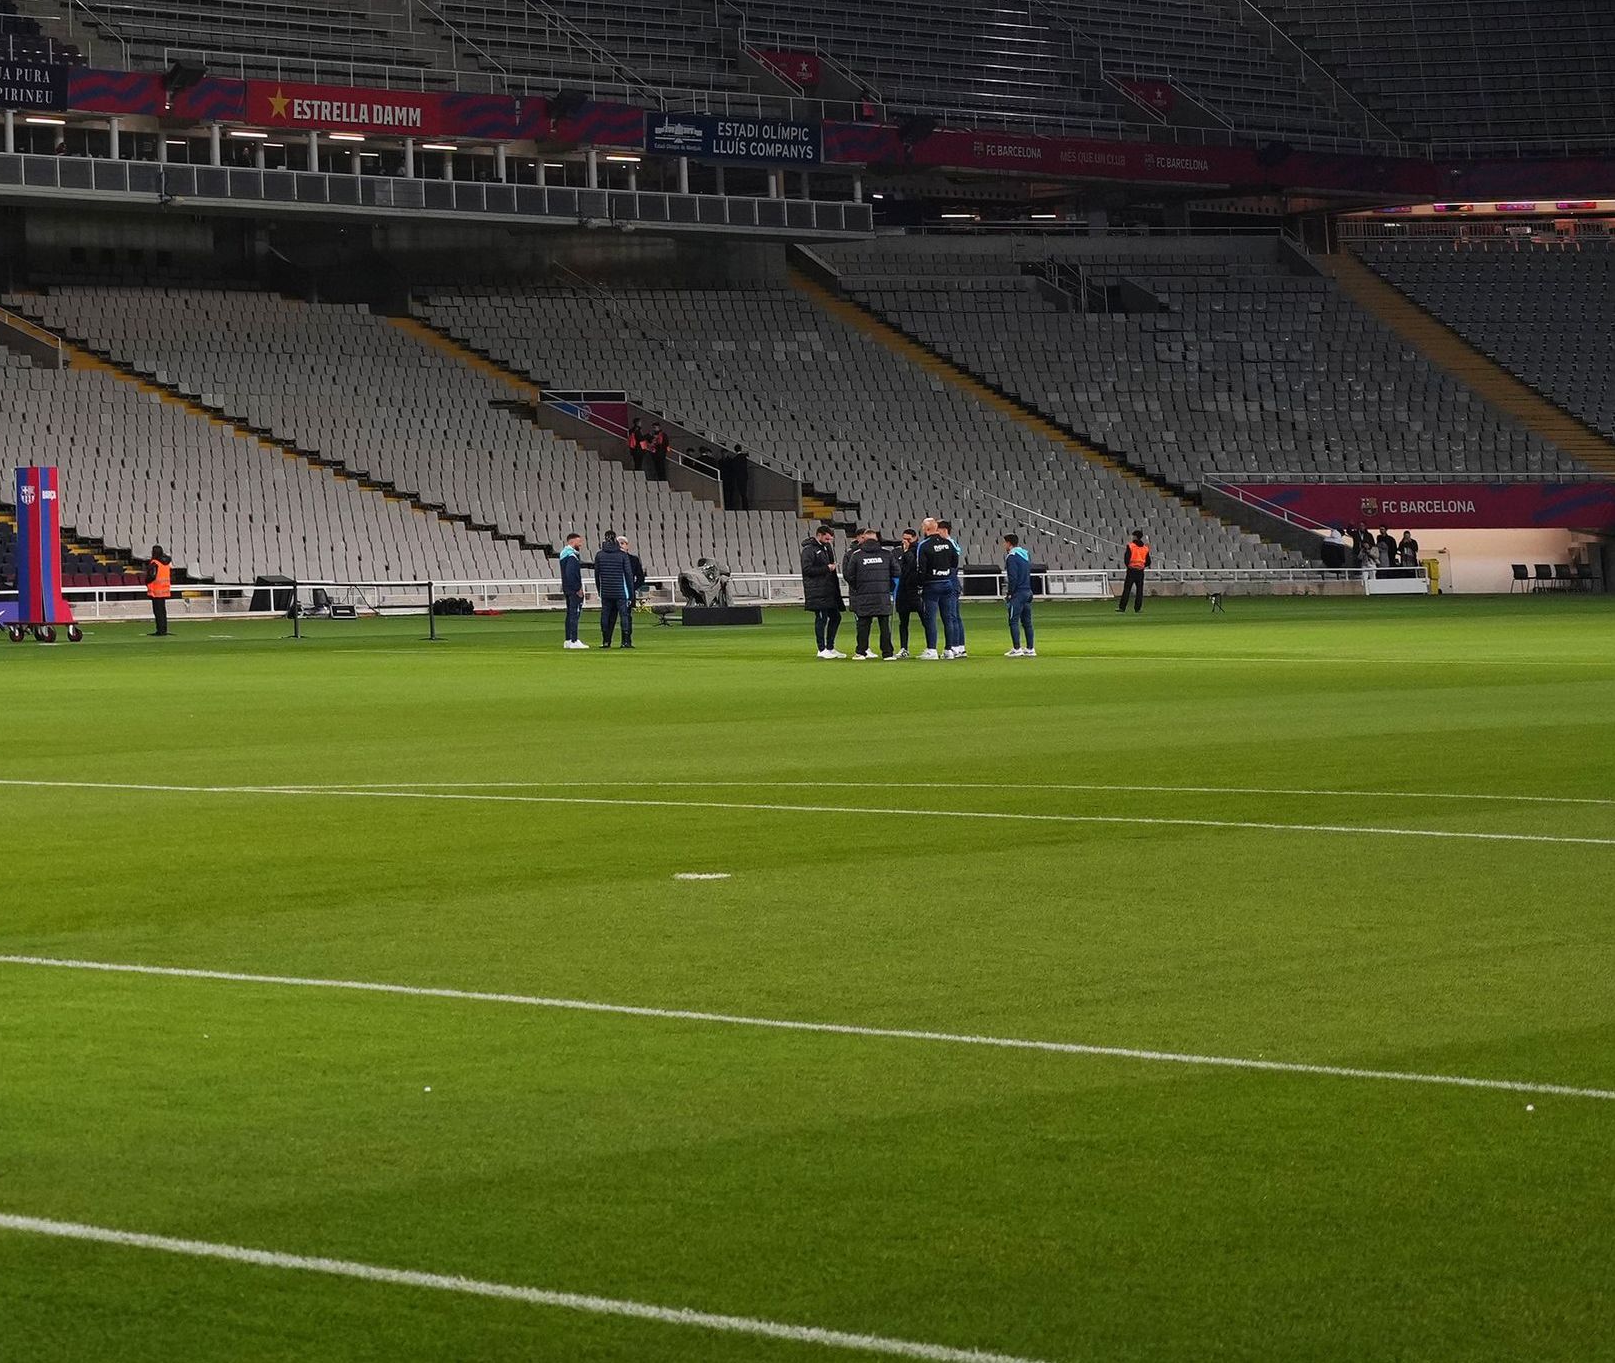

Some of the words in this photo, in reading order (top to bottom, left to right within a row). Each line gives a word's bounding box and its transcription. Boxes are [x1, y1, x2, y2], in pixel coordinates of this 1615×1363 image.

[16, 67, 51, 84] PURA
[293, 99, 370, 124] ESTRELLA
[373, 104, 421, 127] DAMM
[718, 122, 759, 138] ESTADI
[762, 123, 810, 141] OLÍMPIC
[713, 138, 747, 155] LLUÍS
[750, 142, 814, 159] COMPANYS
[986, 145, 997, 157] FC
[997, 145, 1042, 159] BARCELONA
[1156, 158, 1165, 168] FC
[1167, 158, 1208, 171] BARCELONA
[1382, 501, 1397, 514] FC
[1400, 500, 1476, 513] BARCELONA
